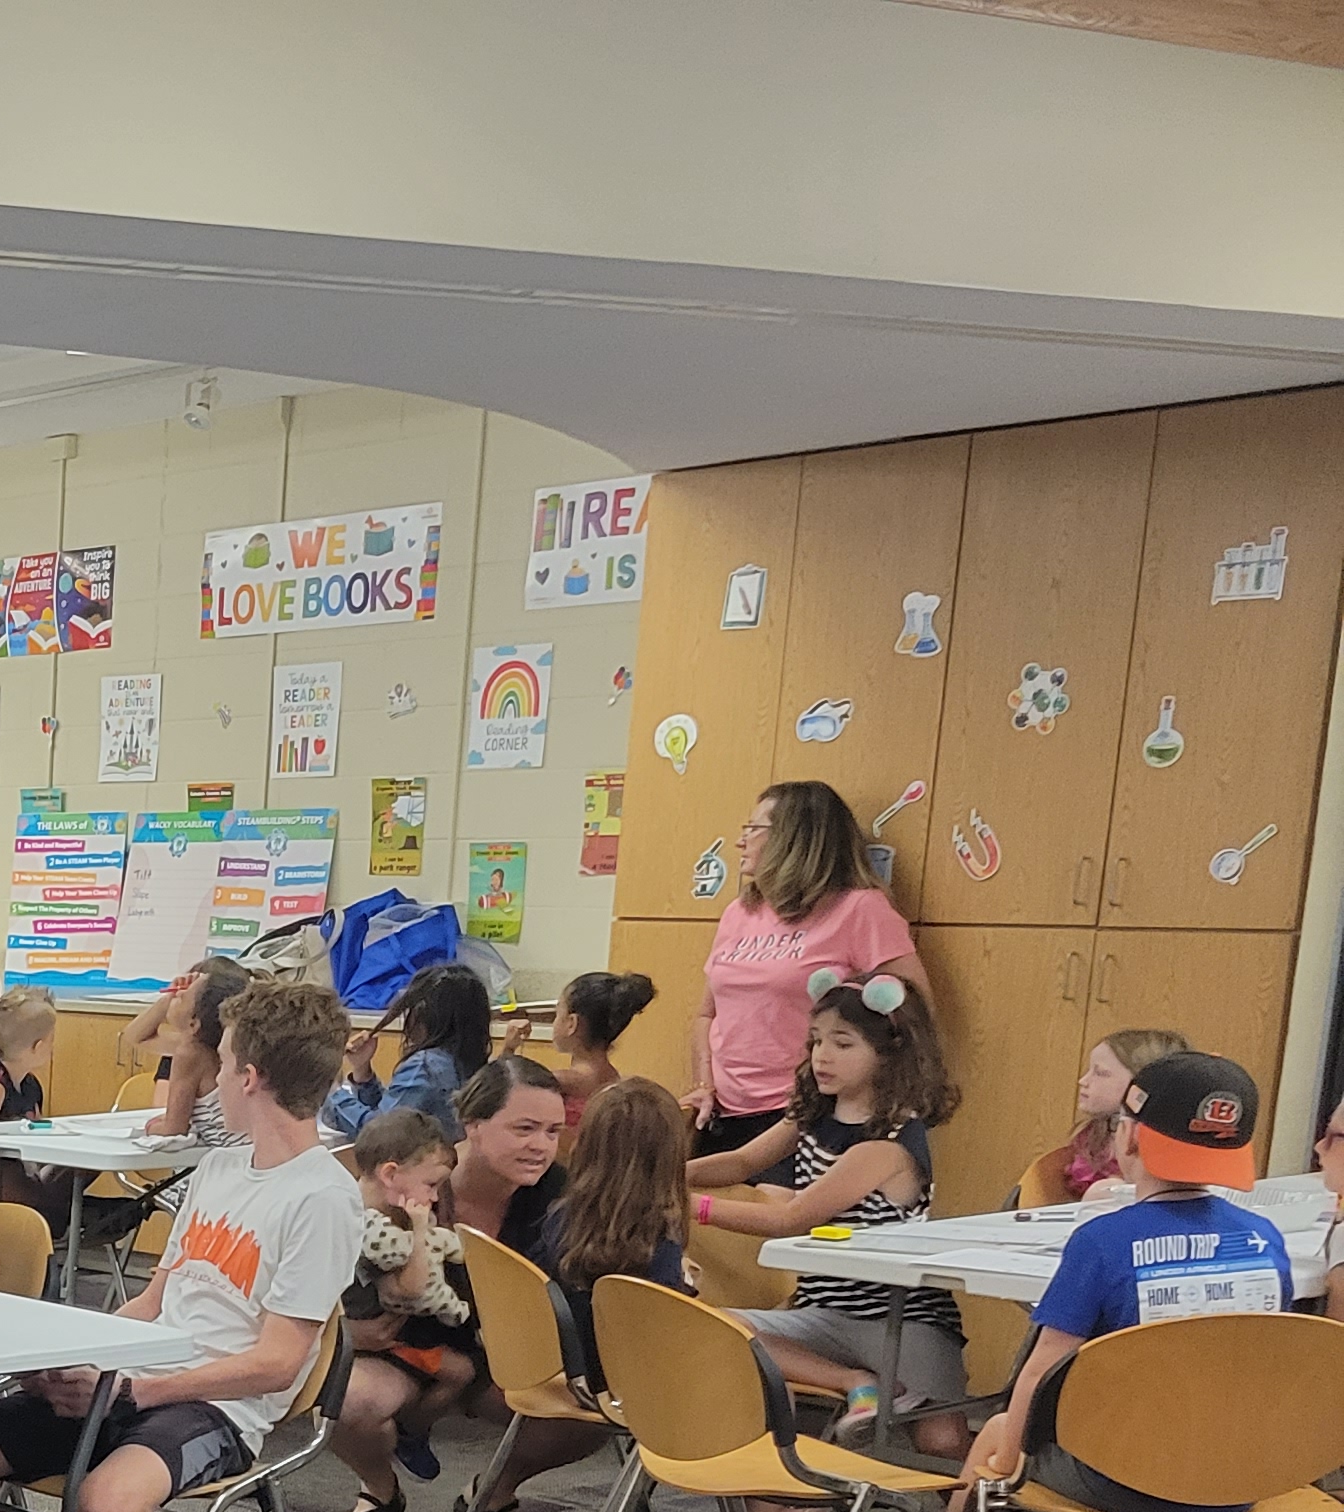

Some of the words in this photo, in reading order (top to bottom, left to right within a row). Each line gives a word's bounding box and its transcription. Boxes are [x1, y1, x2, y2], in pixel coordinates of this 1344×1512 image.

[288, 524, 347, 569] WE
[22, 558, 38, 568] Take
[40, 556, 53, 567] you
[84, 550, 112, 561] Inspire
[42, 568, 52, 577] an
[86, 563, 100, 574] you
[605, 554, 636, 590] IS
[14, 579, 52, 593] ADVENTURE
[91, 583, 109, 600] BIG
[218, 580, 296, 626] LOVE
[302, 567, 412, 618] BOOKS
[288, 673, 317, 686] Today
[284, 687, 330, 703] READER
[285, 714, 328, 728] LEADER
[485, 737, 528, 751] CORNER
[37, 822, 53, 830] THE
[54, 821, 77, 830] LAWS
[302, 816, 324, 824] STEPS
[49, 858, 54, 866] 2
[278, 871, 284, 880] 2
[736, 930, 807, 949] UNDER
[1132, 1235, 1187, 1267] ROUND
[1189, 1233, 1220, 1259] TRIP
[1147, 1286, 1180, 1306] HOME
[1205, 1281, 1234, 1301] HOME
